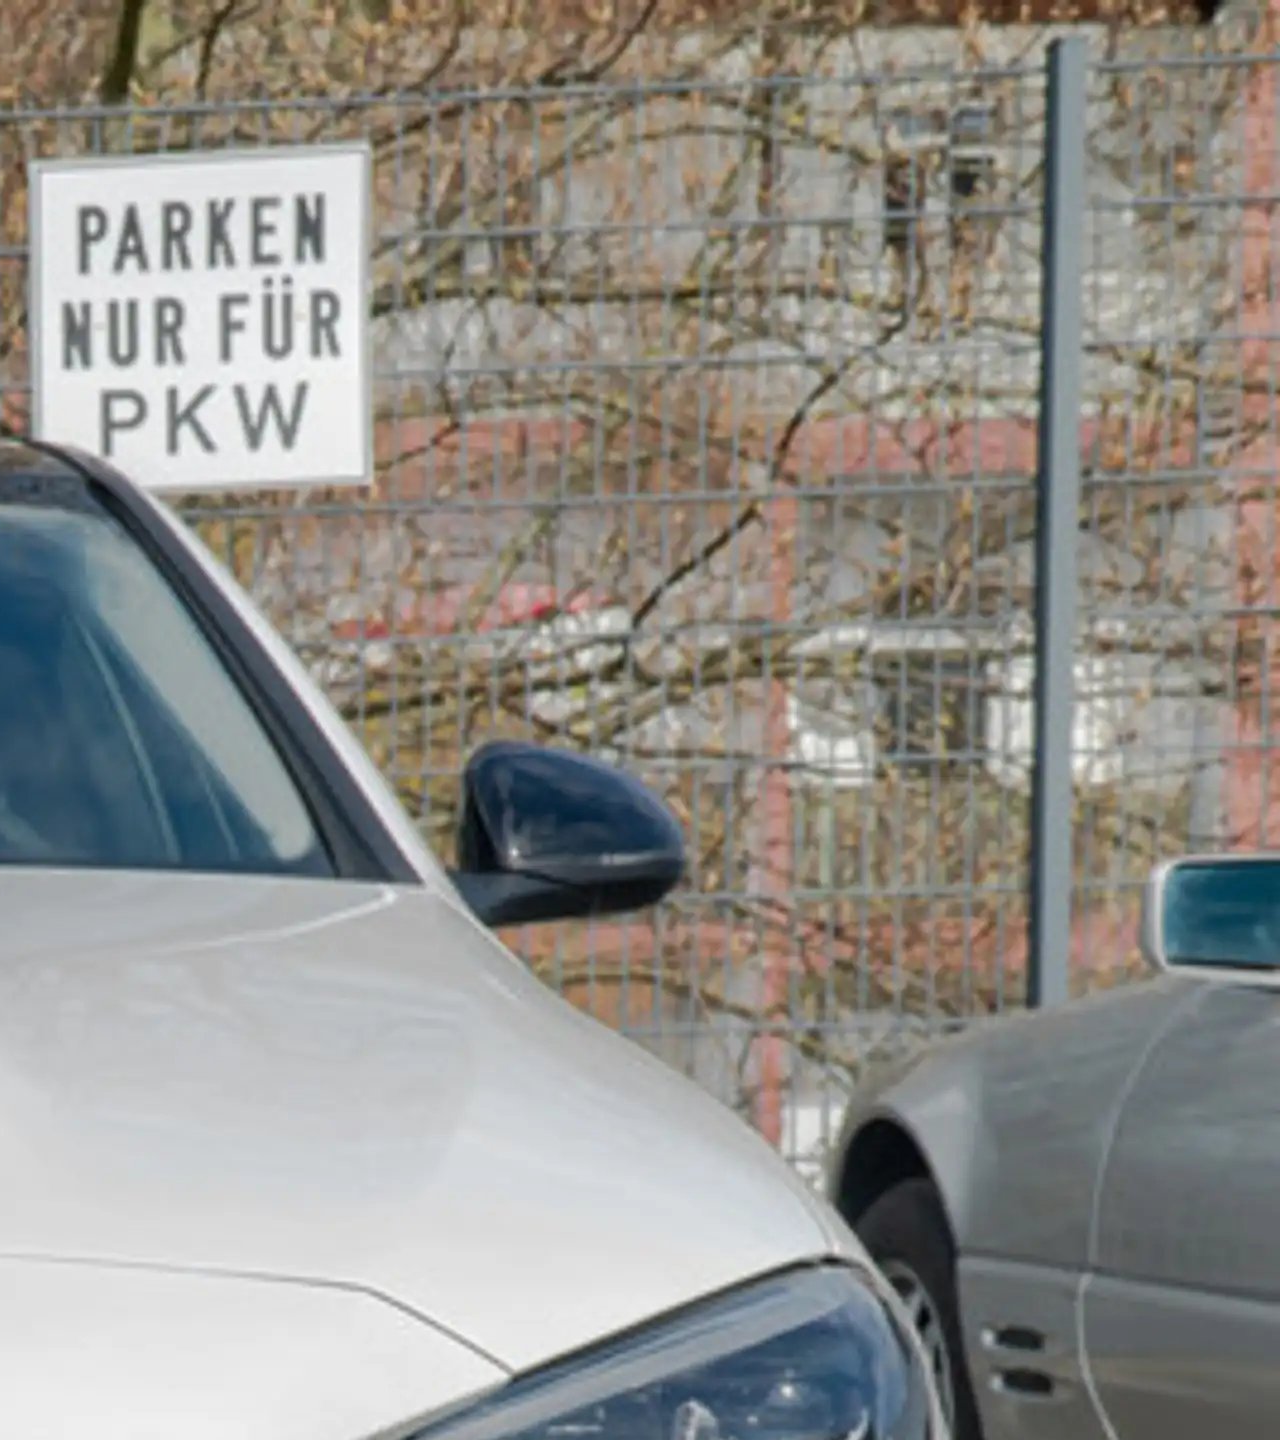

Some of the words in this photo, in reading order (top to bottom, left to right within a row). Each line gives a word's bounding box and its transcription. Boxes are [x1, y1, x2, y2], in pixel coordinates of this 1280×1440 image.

[76, 192, 327, 275] PARKEN
[61, 296, 186, 371] NUR
[217, 274, 341, 363] FÜR
[99, 379, 309, 457] PKW
